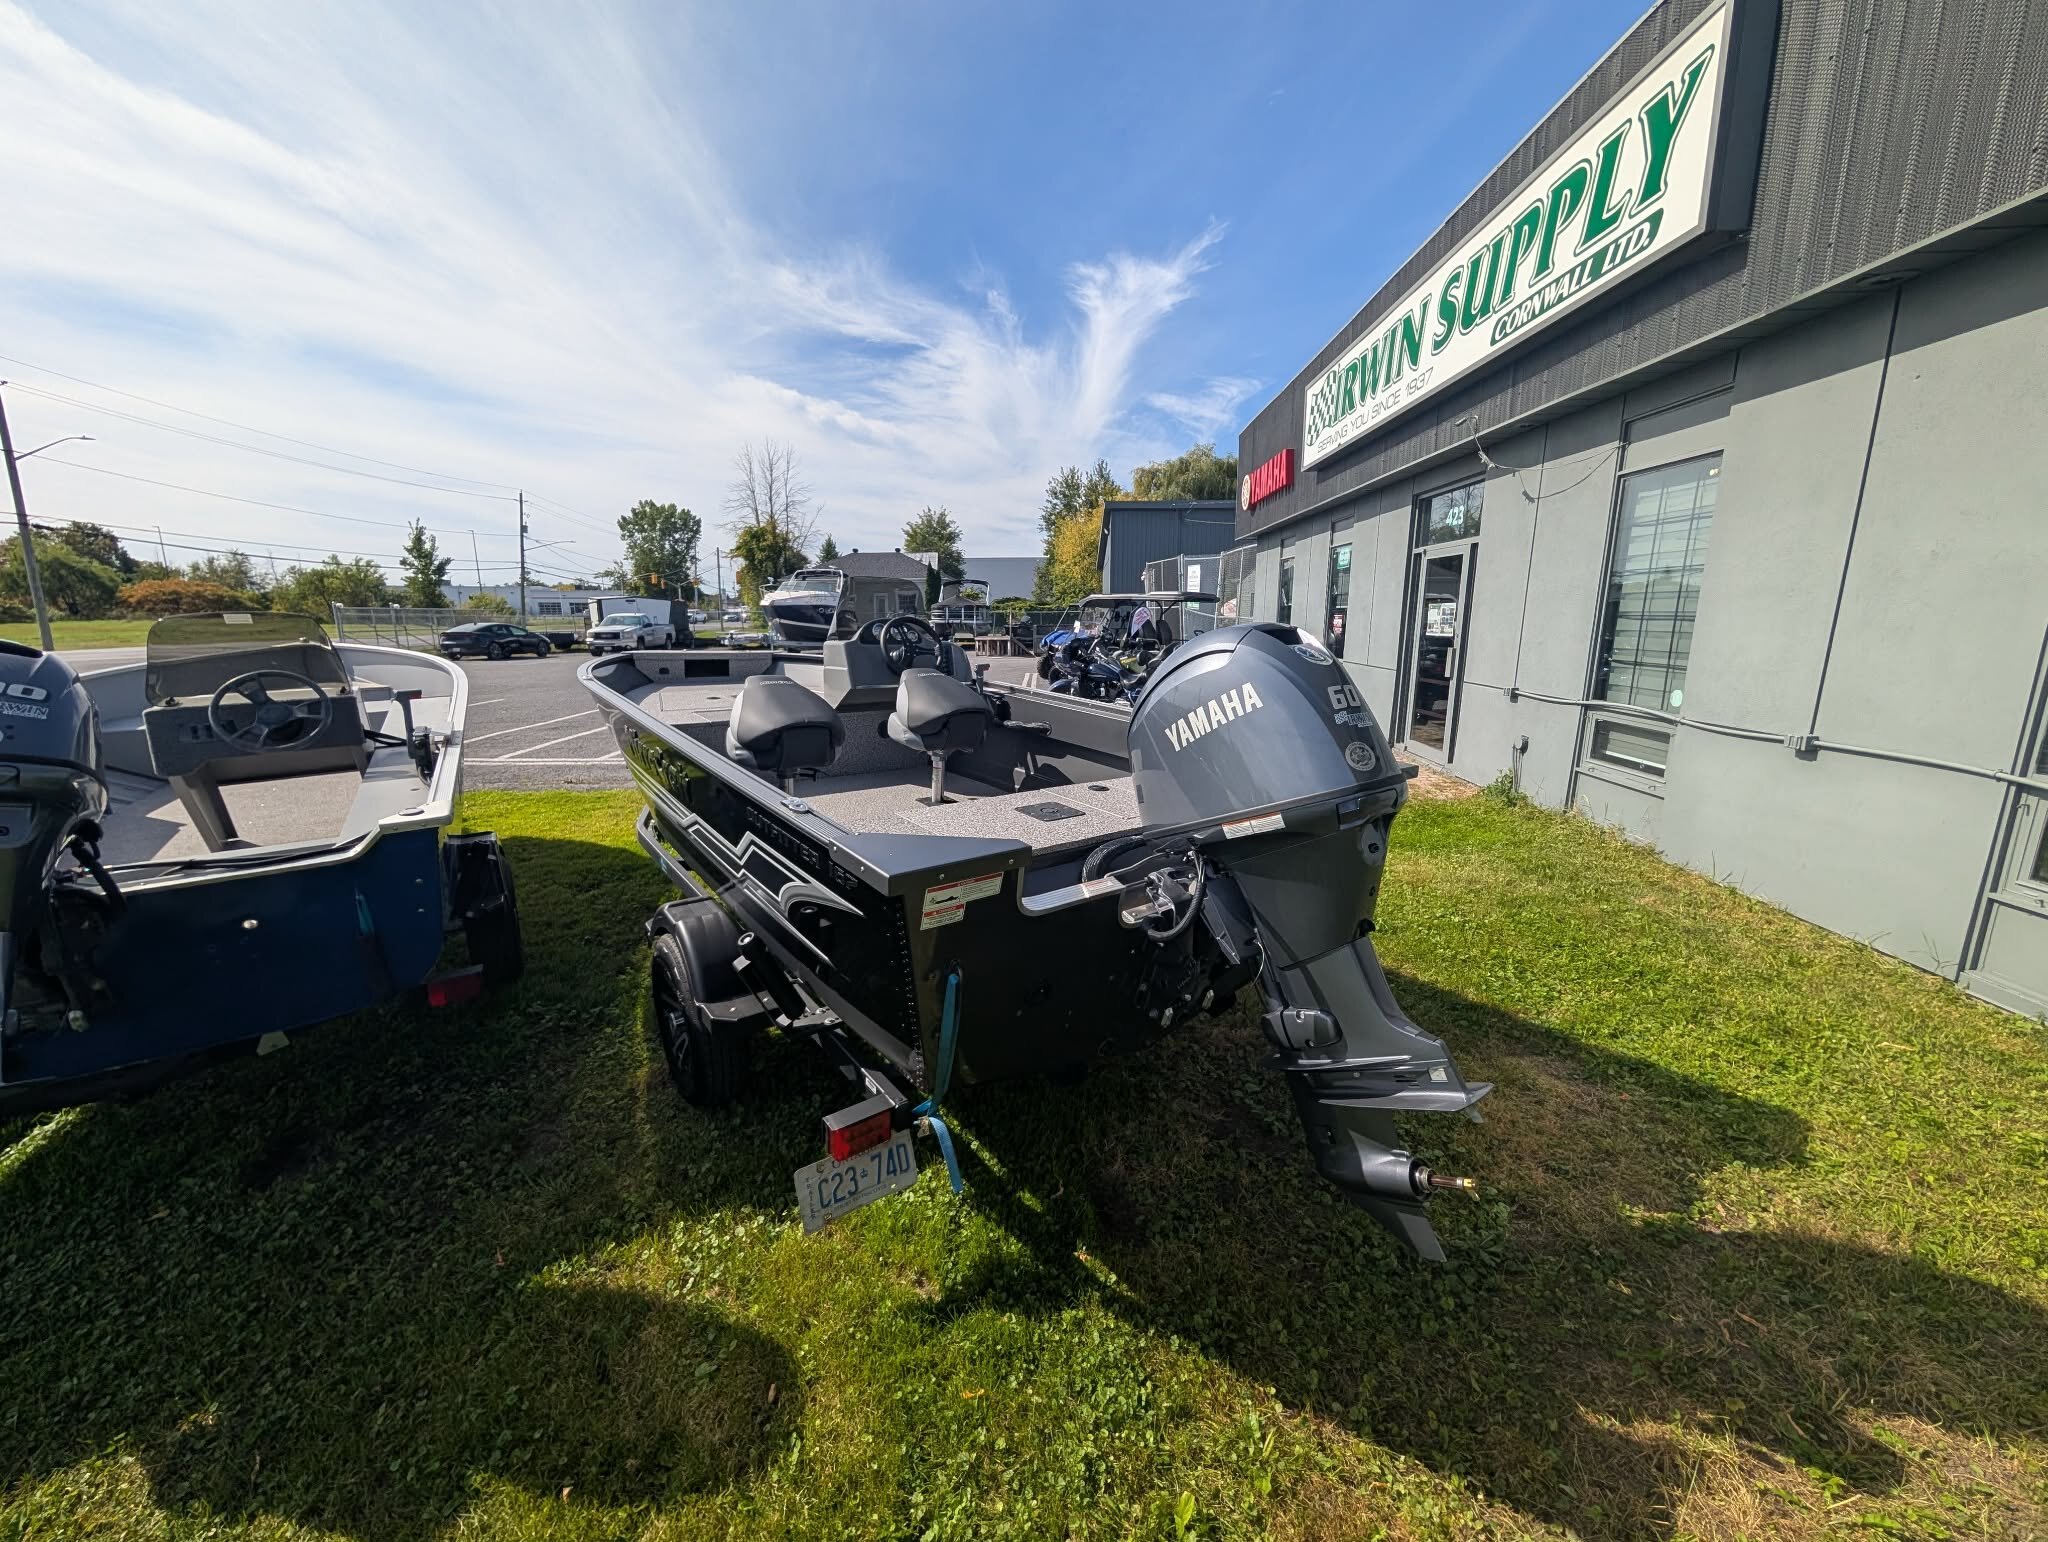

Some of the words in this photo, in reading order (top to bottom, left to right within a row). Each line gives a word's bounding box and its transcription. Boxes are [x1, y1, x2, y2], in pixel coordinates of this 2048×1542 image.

[1330, 293, 1432, 427] IRWIN
[1431, 44, 1715, 356] SUPPLY
[1494, 258, 1595, 340] CORNWALL
[1601, 221, 1651, 274] LTD.
[1317, 426, 1348, 451] SERVING
[1350, 411, 1370, 431] YOU
[1371, 391, 1401, 417] SINCE
[1406, 367, 1433, 397] 1937
[1251, 449, 1286, 504] YAMAHA
[1445, 505, 1464, 526] 423
[1164, 682, 1263, 751] YAMAHA
[1327, 684, 1361, 709] 60
[818, 1166, 859, 1209] C23
